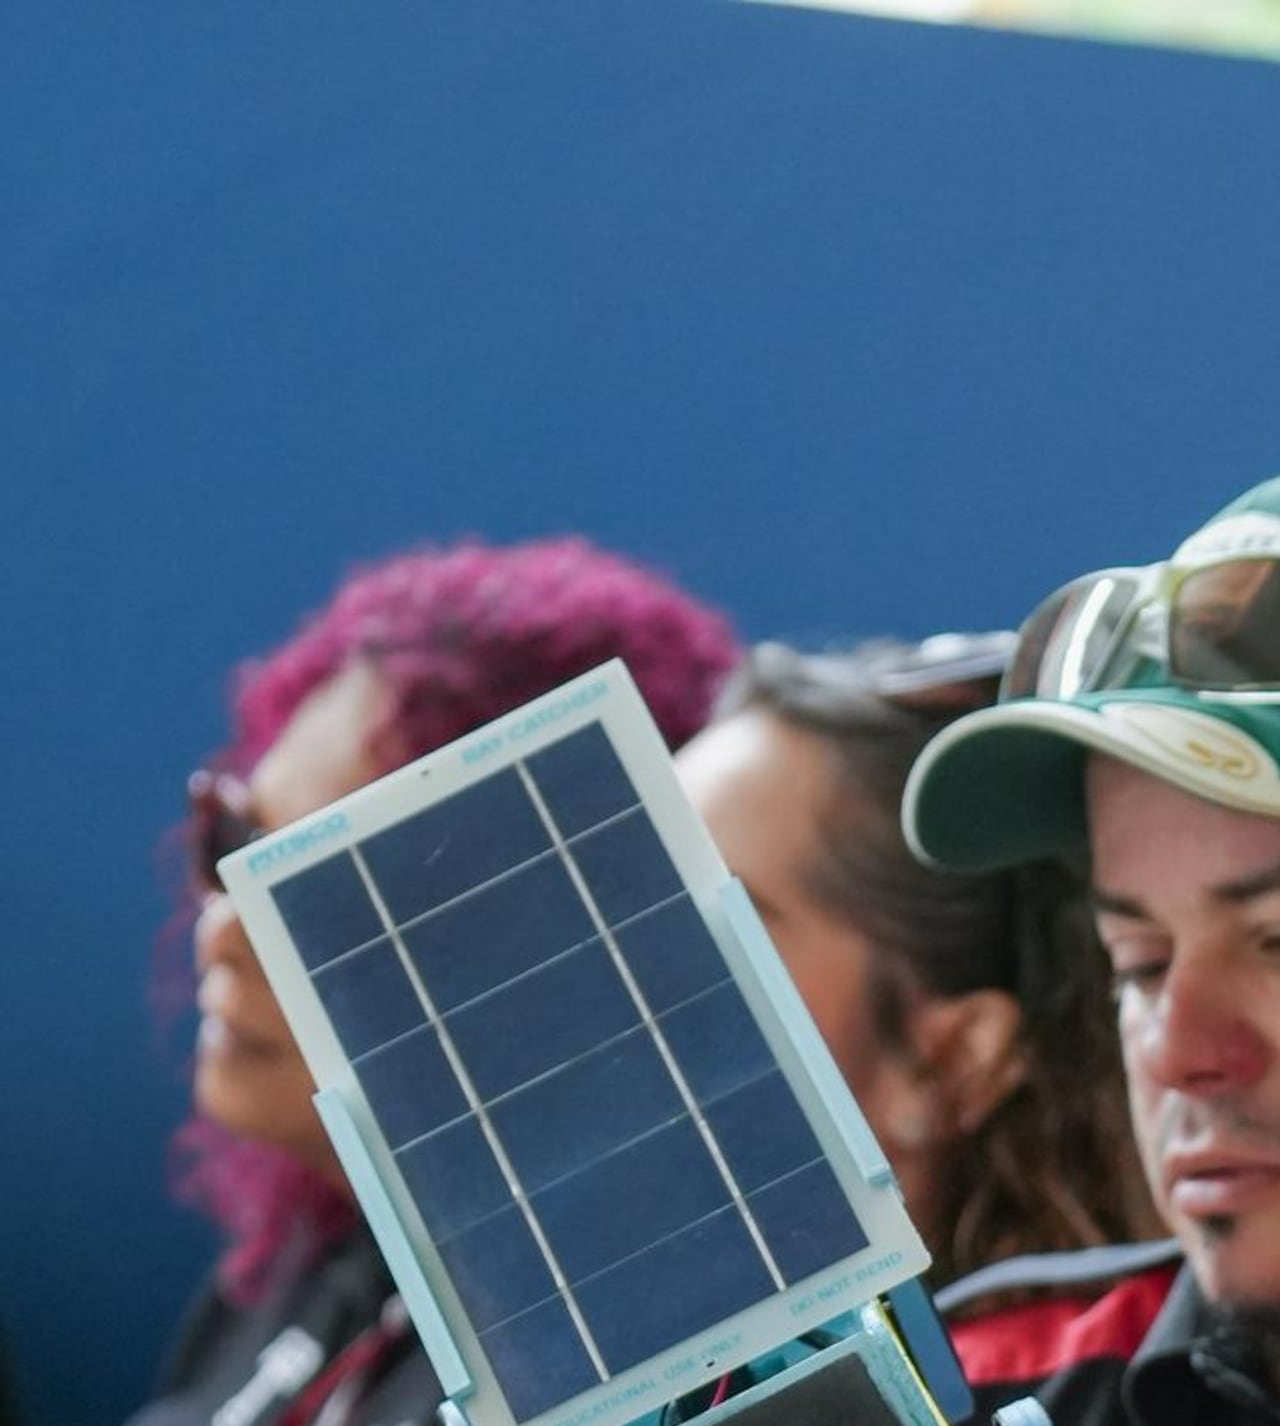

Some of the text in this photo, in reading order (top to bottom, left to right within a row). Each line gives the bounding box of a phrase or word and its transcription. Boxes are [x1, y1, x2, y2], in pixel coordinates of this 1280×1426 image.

[787, 1249, 903, 1316] DO NOT BEND
[661, 1354, 698, 1381] USE
[698, 1331, 744, 1362] ONLY
